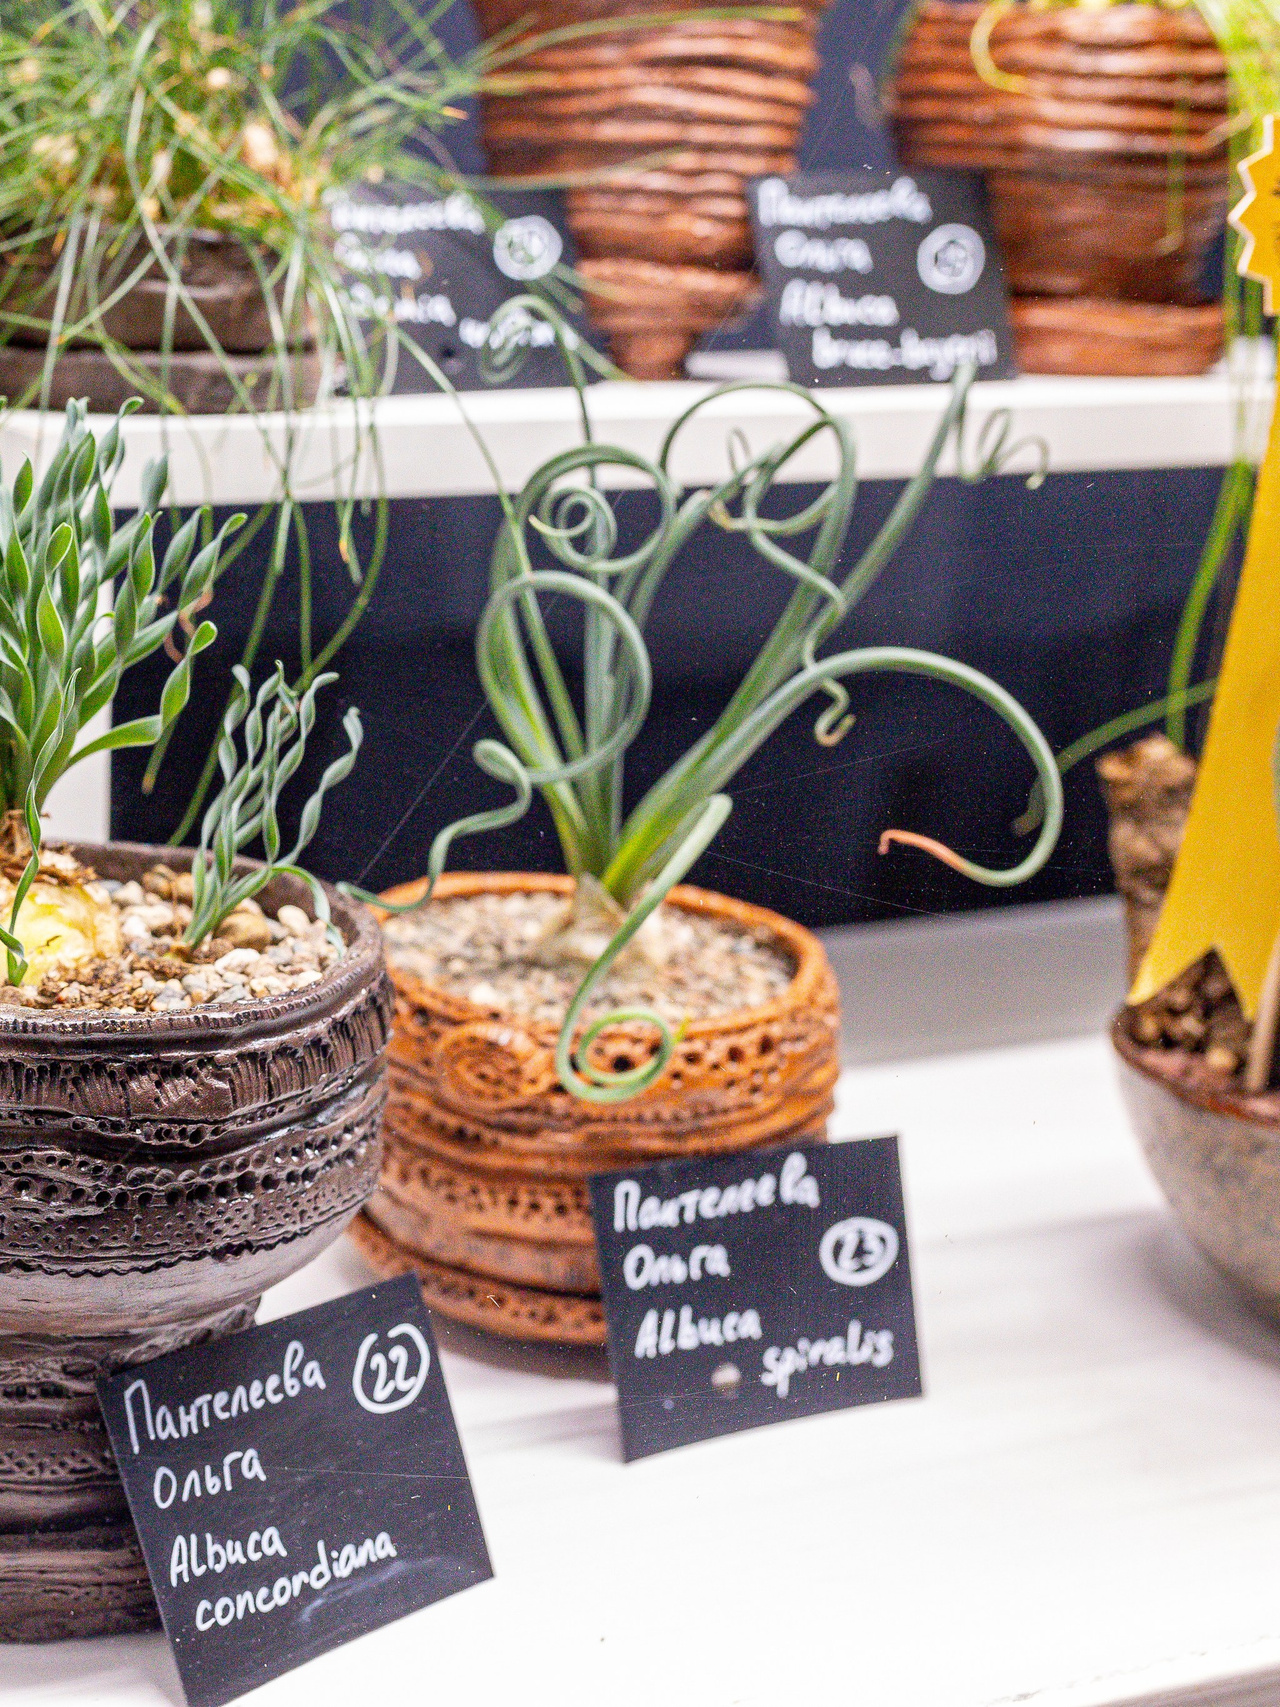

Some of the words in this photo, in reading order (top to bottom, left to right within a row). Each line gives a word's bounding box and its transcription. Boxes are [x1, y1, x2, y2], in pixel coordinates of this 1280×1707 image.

[634, 1304, 763, 1359] Albuca
[760, 1319, 894, 1399] spiralis
[124, 1340, 326, 1455] Пантелеева
[369, 1345, 418, 1402] 22
[153, 1448, 267, 1509] Ольга
[169, 1526, 288, 1588] Albuca
[195, 1531, 398, 1632] concordiana
